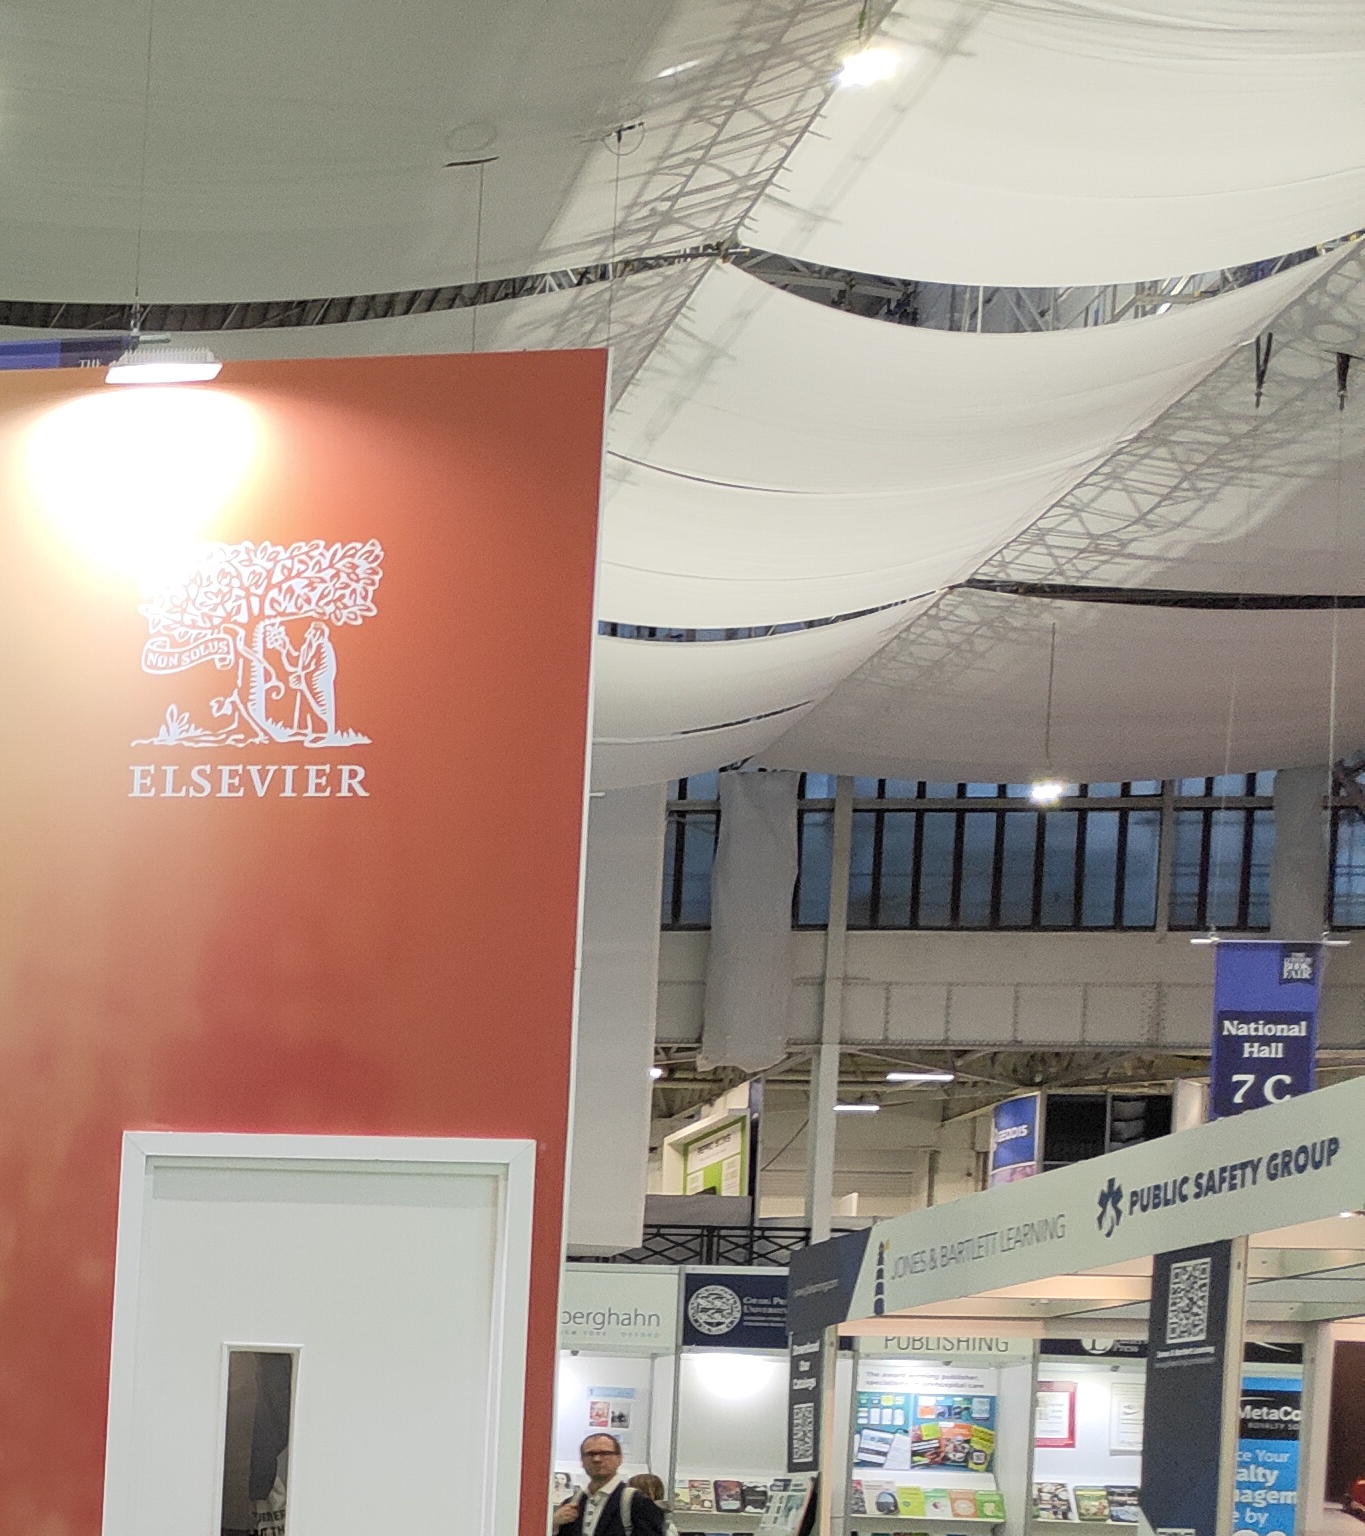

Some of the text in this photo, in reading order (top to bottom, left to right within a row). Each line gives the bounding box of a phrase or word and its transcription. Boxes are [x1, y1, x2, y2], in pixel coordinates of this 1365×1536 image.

[146, 640, 228, 668] NON SOLUS
[128, 764, 370, 797] ELSEVIER
[1222, 1020, 1307, 1037] National
[1242, 1042, 1284, 1058] Hall
[1128, 1136, 1340, 1216] PUBLIC SAFETY GROUP
[890, 1213, 1066, 1281] JONES & BARTLETT LEARNING
[1255, 1449, 1291, 1463] Your
[1244, 1508, 1270, 1527] by
